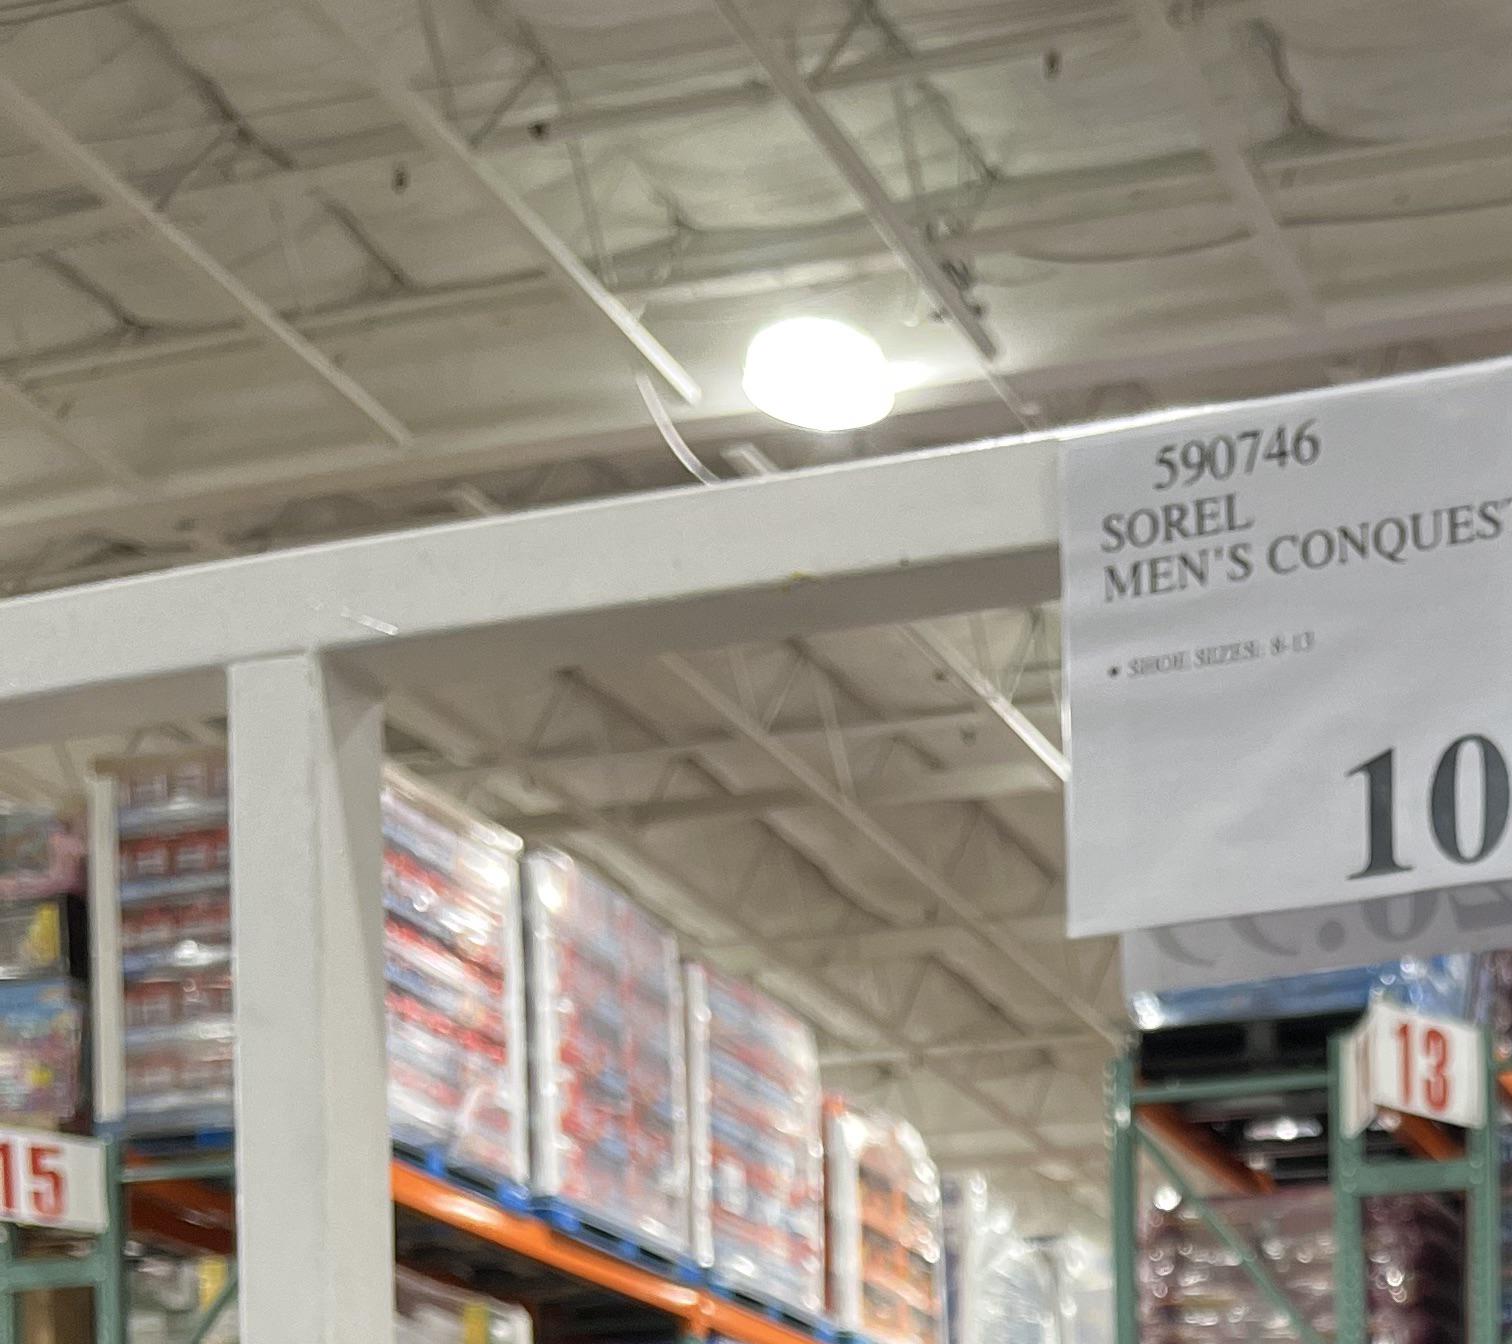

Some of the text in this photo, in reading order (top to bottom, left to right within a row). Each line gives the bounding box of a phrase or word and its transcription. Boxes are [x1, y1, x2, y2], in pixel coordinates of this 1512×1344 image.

[1152, 418, 1322, 490] 590746
[1100, 493, 1254, 553] SOREL
[1103, 542, 1254, 603] MEN'S
[1396, 1022, 1449, 1114] 13
[0, 1143, 67, 1219] 15
